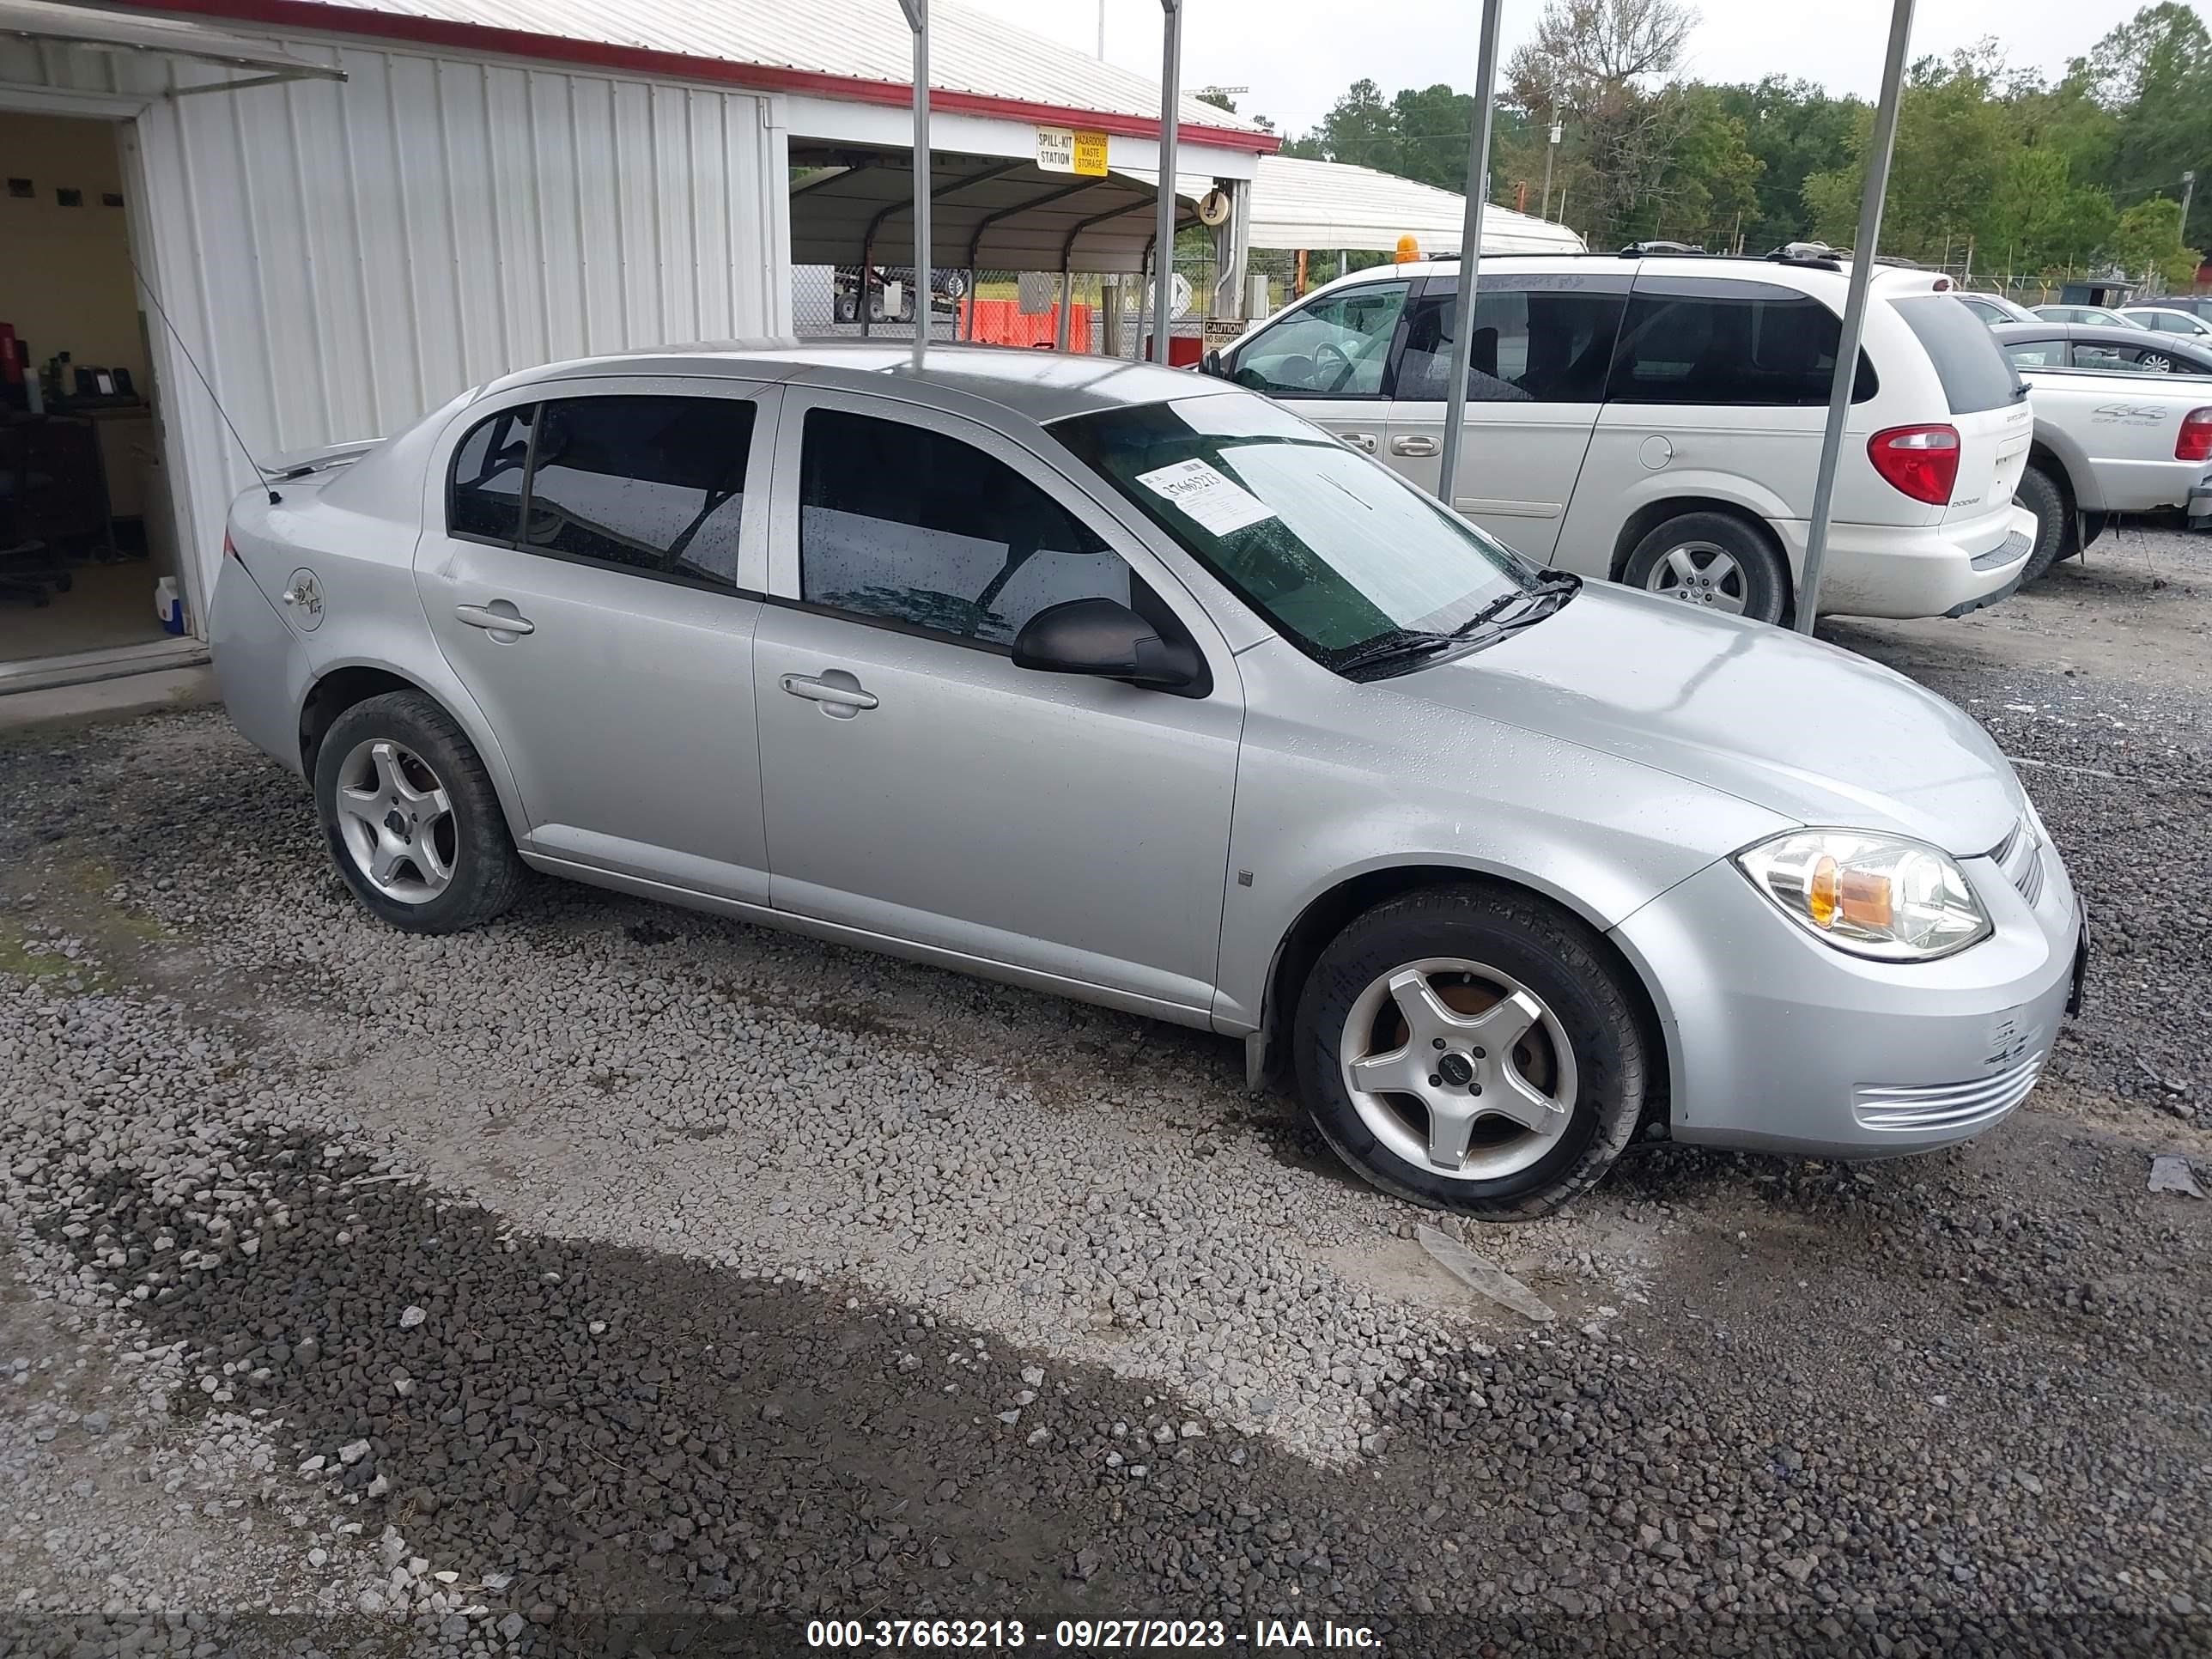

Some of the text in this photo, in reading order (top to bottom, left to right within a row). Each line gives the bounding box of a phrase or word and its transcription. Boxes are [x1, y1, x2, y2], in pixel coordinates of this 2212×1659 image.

[1038, 132, 1073, 149] SPILL-KIT
[1074, 135, 1107, 148] HAZARDOUS
[1041, 150, 1070, 166] STATION
[1082, 148, 1100, 158] WASTE
[1078, 158, 1103, 169] STORAGE
[1206, 323, 1243, 334] CAUTION
